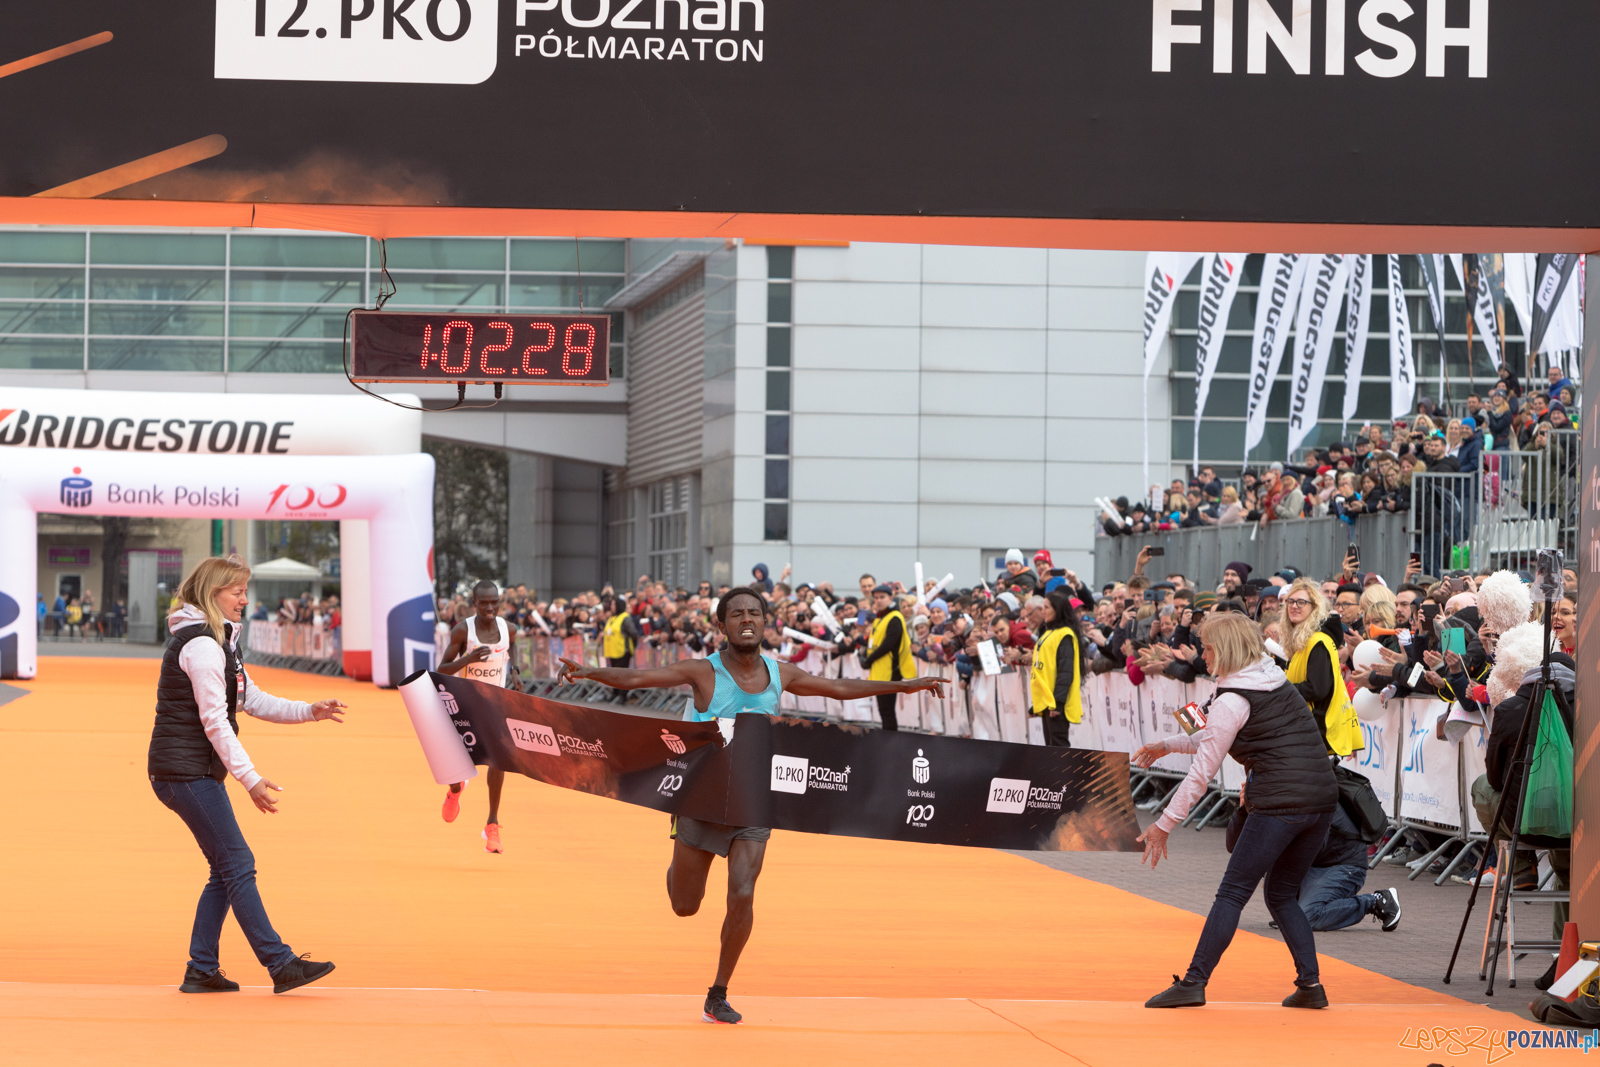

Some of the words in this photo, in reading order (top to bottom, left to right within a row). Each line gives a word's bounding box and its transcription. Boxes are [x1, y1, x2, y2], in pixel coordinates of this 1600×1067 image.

[515, 28, 764, 62] PÓŁMARATON
[1151, 0, 1489, 78] FINISH
[0, 409, 293, 454] BRIDGESTONE
[107, 483, 164, 506] Bank
[174, 486, 239, 508] Polski
[265, 483, 347, 514] 100
[513, 727, 553, 747] 12.PKO
[775, 765, 804, 783] 12.PKO
[808, 780, 848, 792] PÓŁMARATON
[907, 789, 920, 798] Bank
[921, 790, 936, 799] Polski
[993, 788, 1025, 804] 12.PKO
[906, 804, 935, 824] 100
